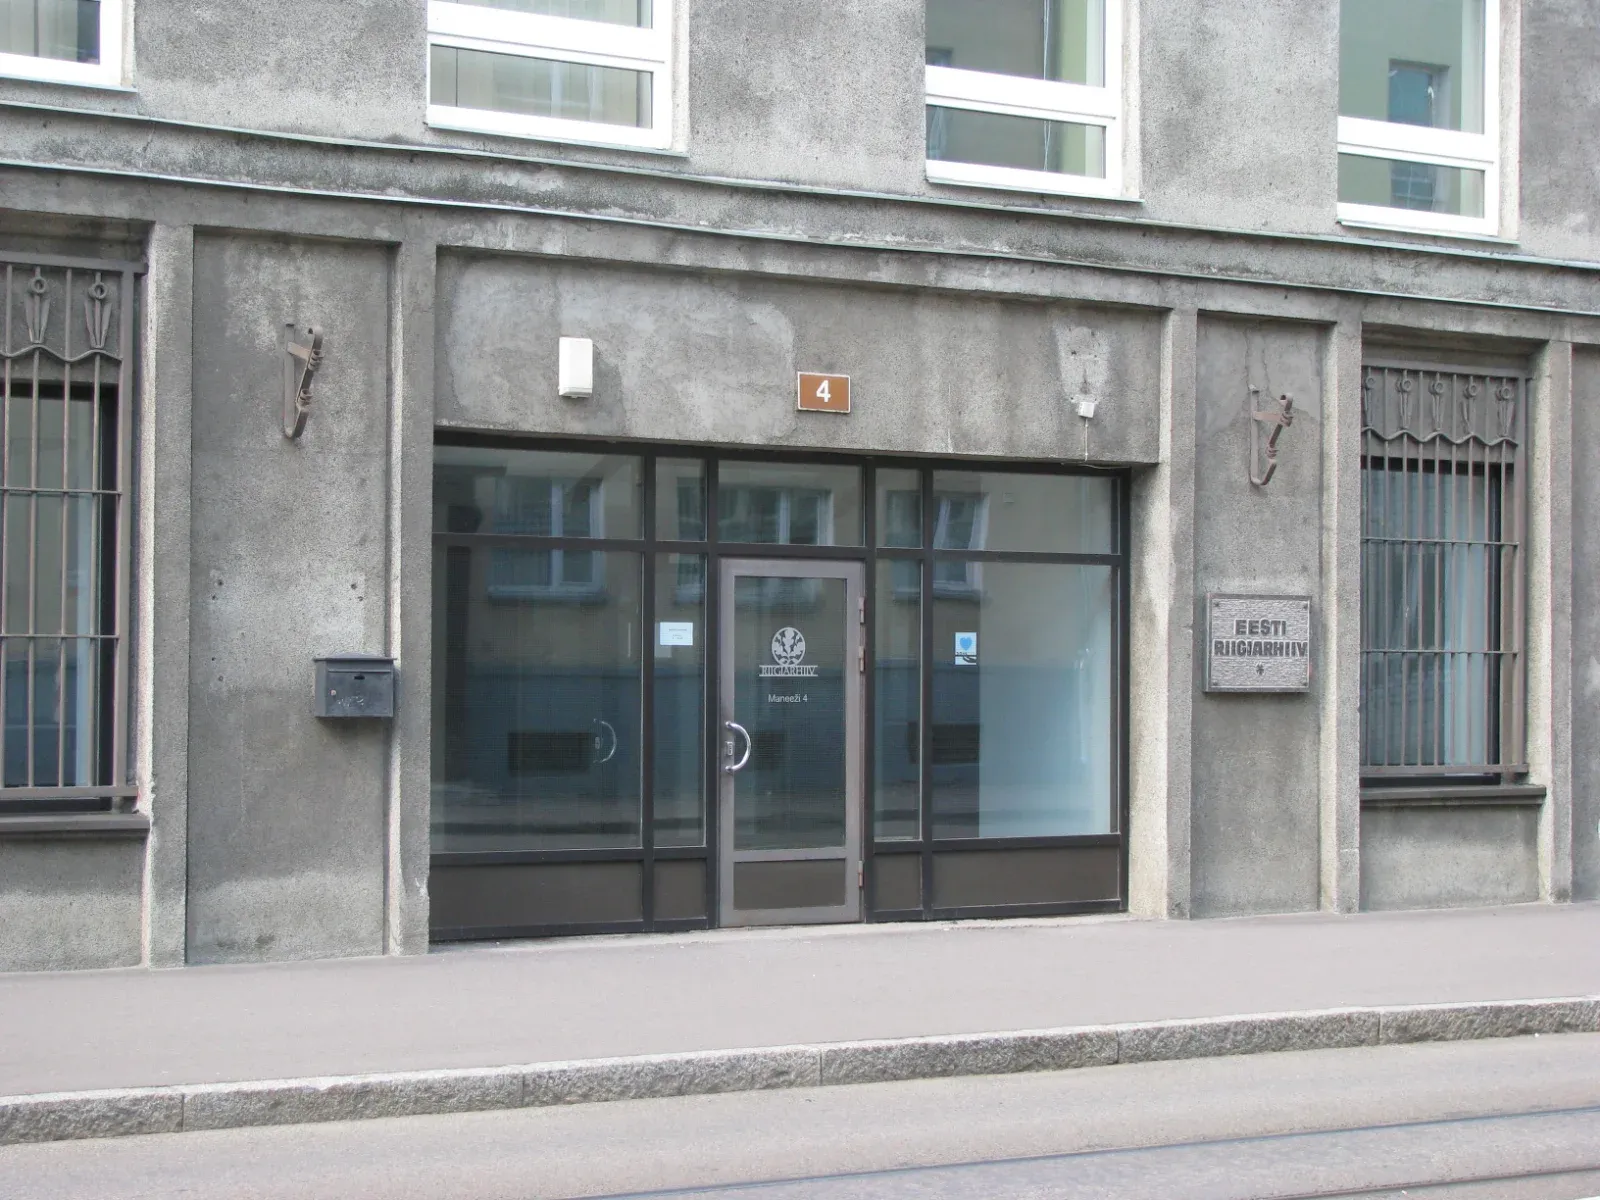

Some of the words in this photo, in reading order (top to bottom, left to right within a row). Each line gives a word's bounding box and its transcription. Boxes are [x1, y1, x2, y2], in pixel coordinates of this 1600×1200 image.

[816, 380, 831, 402] 4
[1235, 618, 1287, 636] EESTI
[1213, 639, 1309, 656] RIIGIARHIIV
[768, 694, 800, 702] Maneeži
[802, 694, 808, 702] 4
